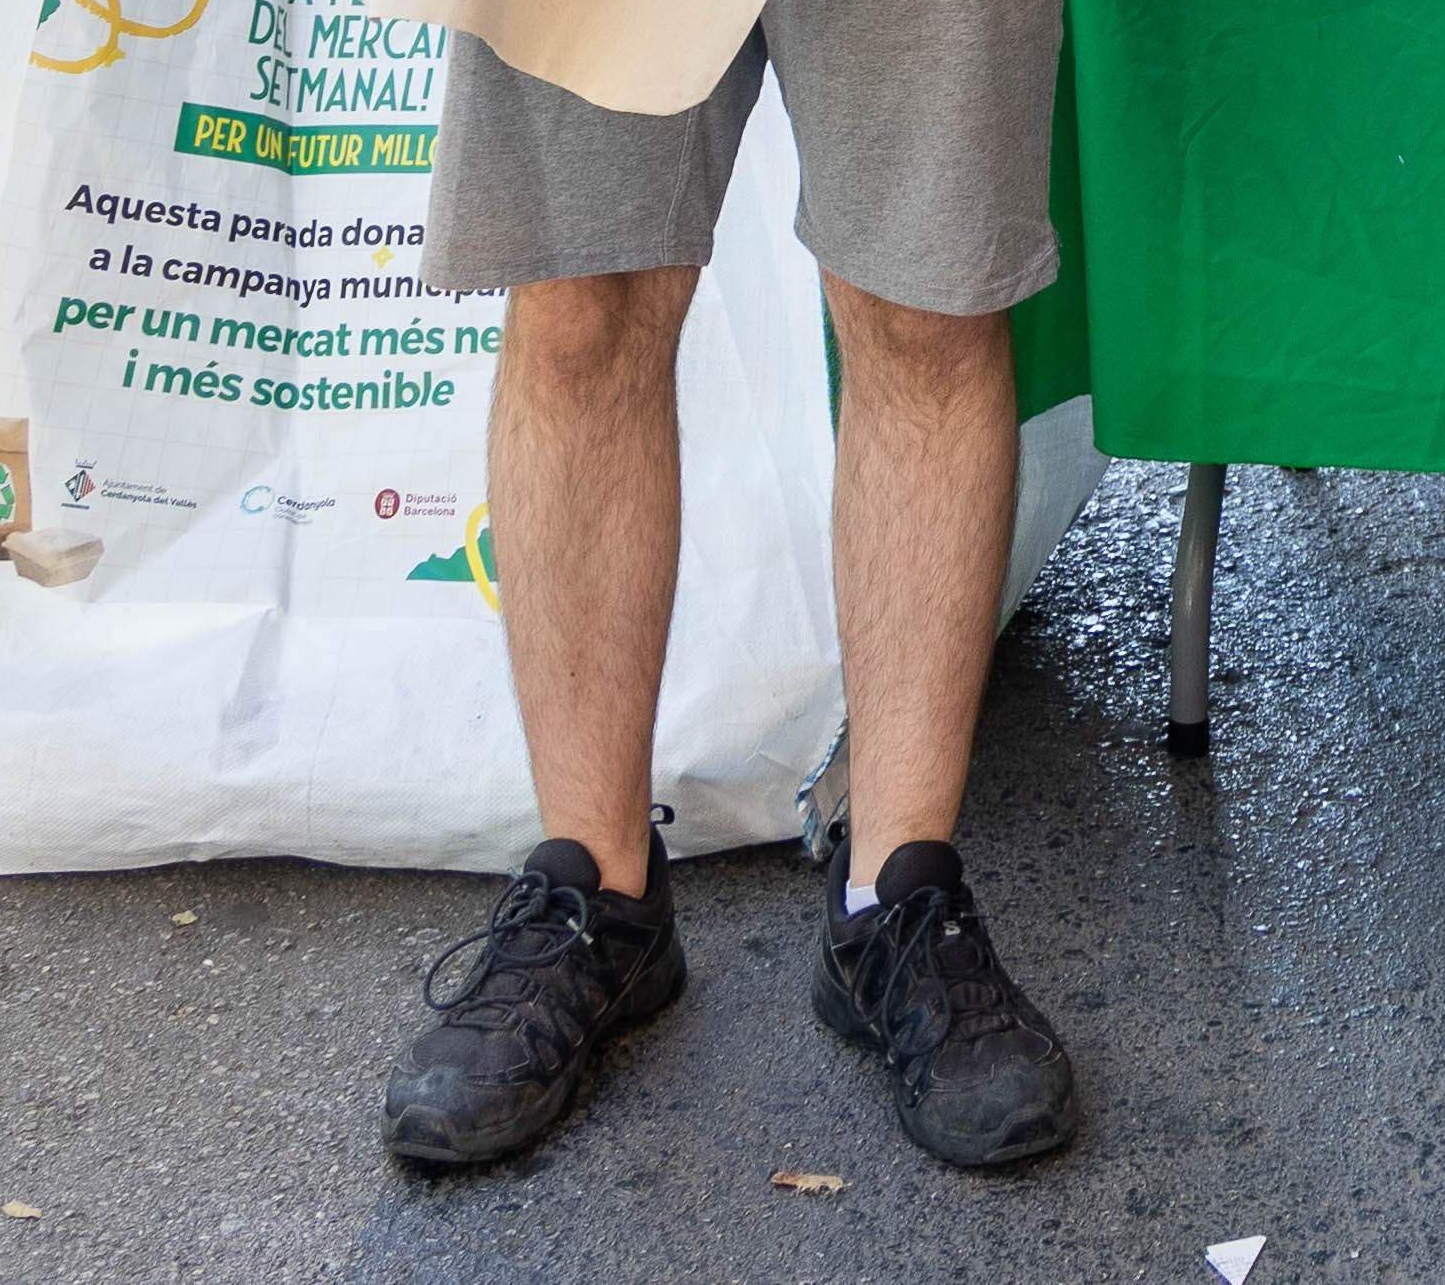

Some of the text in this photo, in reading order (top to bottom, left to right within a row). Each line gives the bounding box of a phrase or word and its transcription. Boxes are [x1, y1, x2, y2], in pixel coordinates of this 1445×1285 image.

[247, 0, 293, 57] DEL
[249, 55, 435, 113] SETMANAL!
[193, 113, 247, 153] PER
[255, 129, 283, 163] UN
[285, 135, 363, 169] FUTUR
[65, 183, 425, 249] Aquesta parada dona
[89, 247, 111, 273] a
[119, 245, 153, 279] la
[161, 257, 331, 309] campanya
[53, 293, 503, 357] per un mercat més ne
[121, 347, 455, 411] i més sostenible
[101, 489, 153, 503] Cerdanyola
[277, 495, 337, 511] Cerdanyola
[403, 505, 457, 517] Barcelona
[405, 491, 457, 507] Diputació
